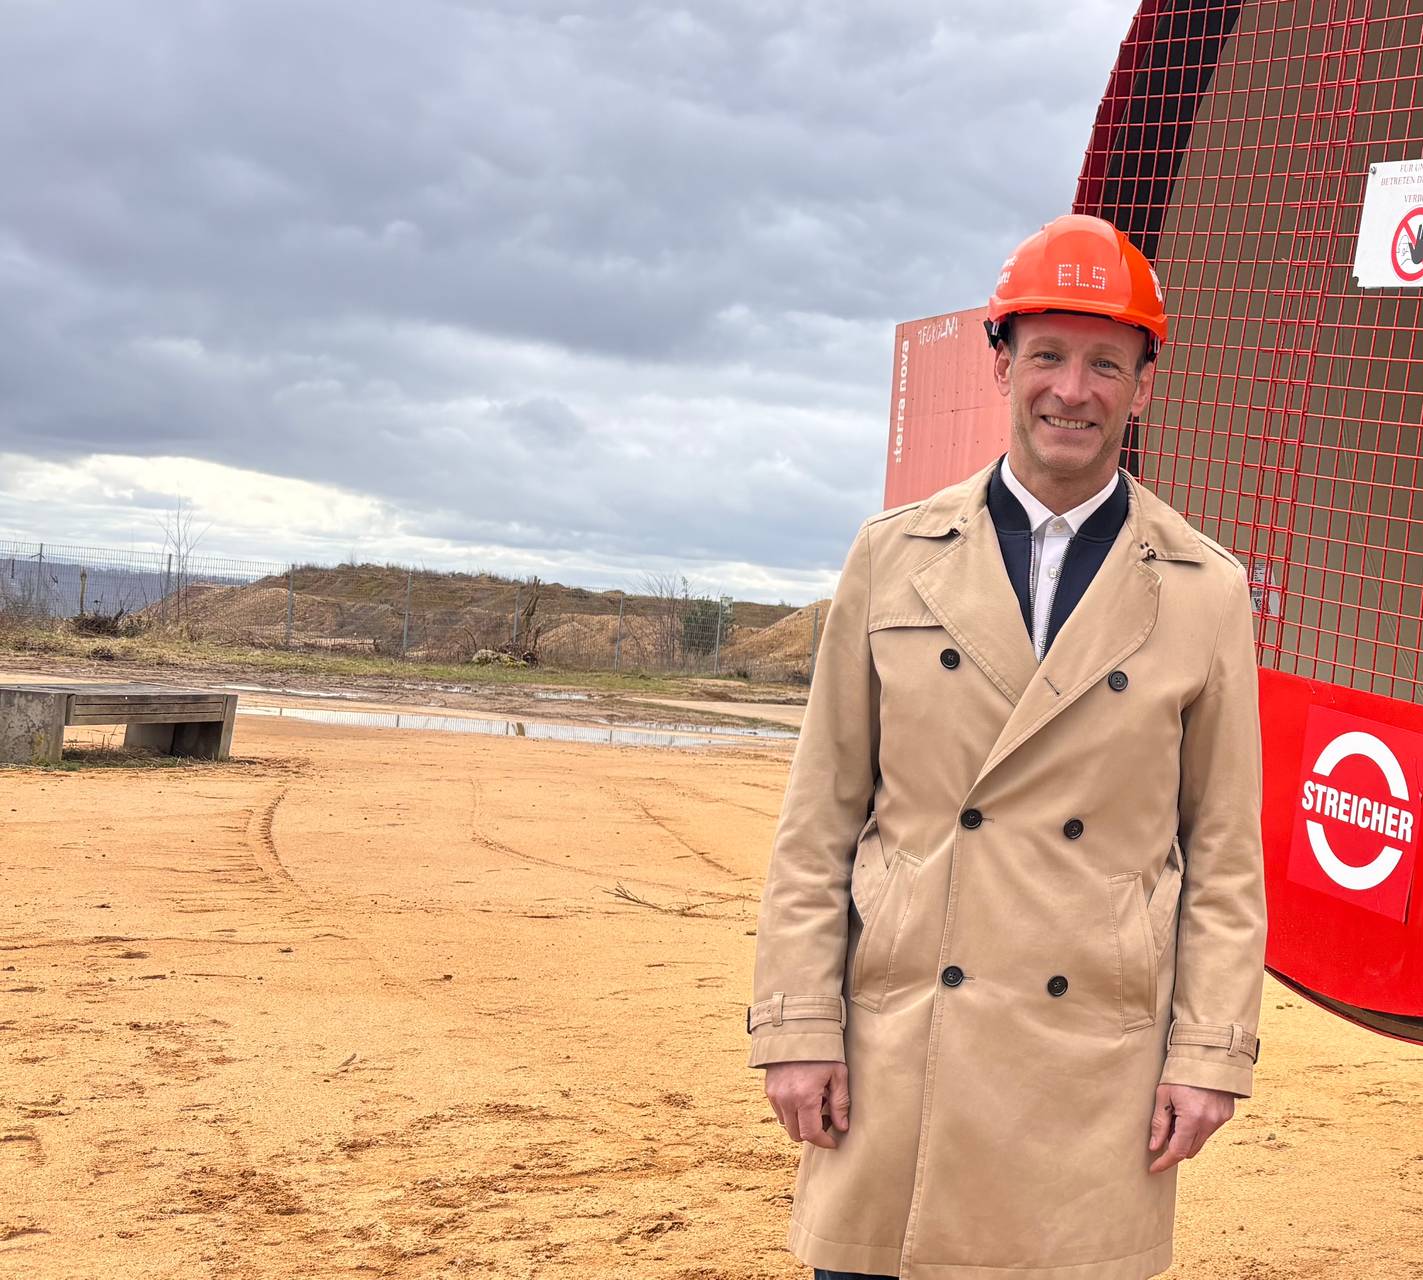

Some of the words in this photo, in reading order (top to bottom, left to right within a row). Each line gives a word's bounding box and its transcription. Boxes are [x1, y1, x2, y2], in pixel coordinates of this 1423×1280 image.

[1058, 264, 1106, 289] ELS
[900, 340, 909, 392] nova
[1302, 780, 1414, 843] STREICHER
